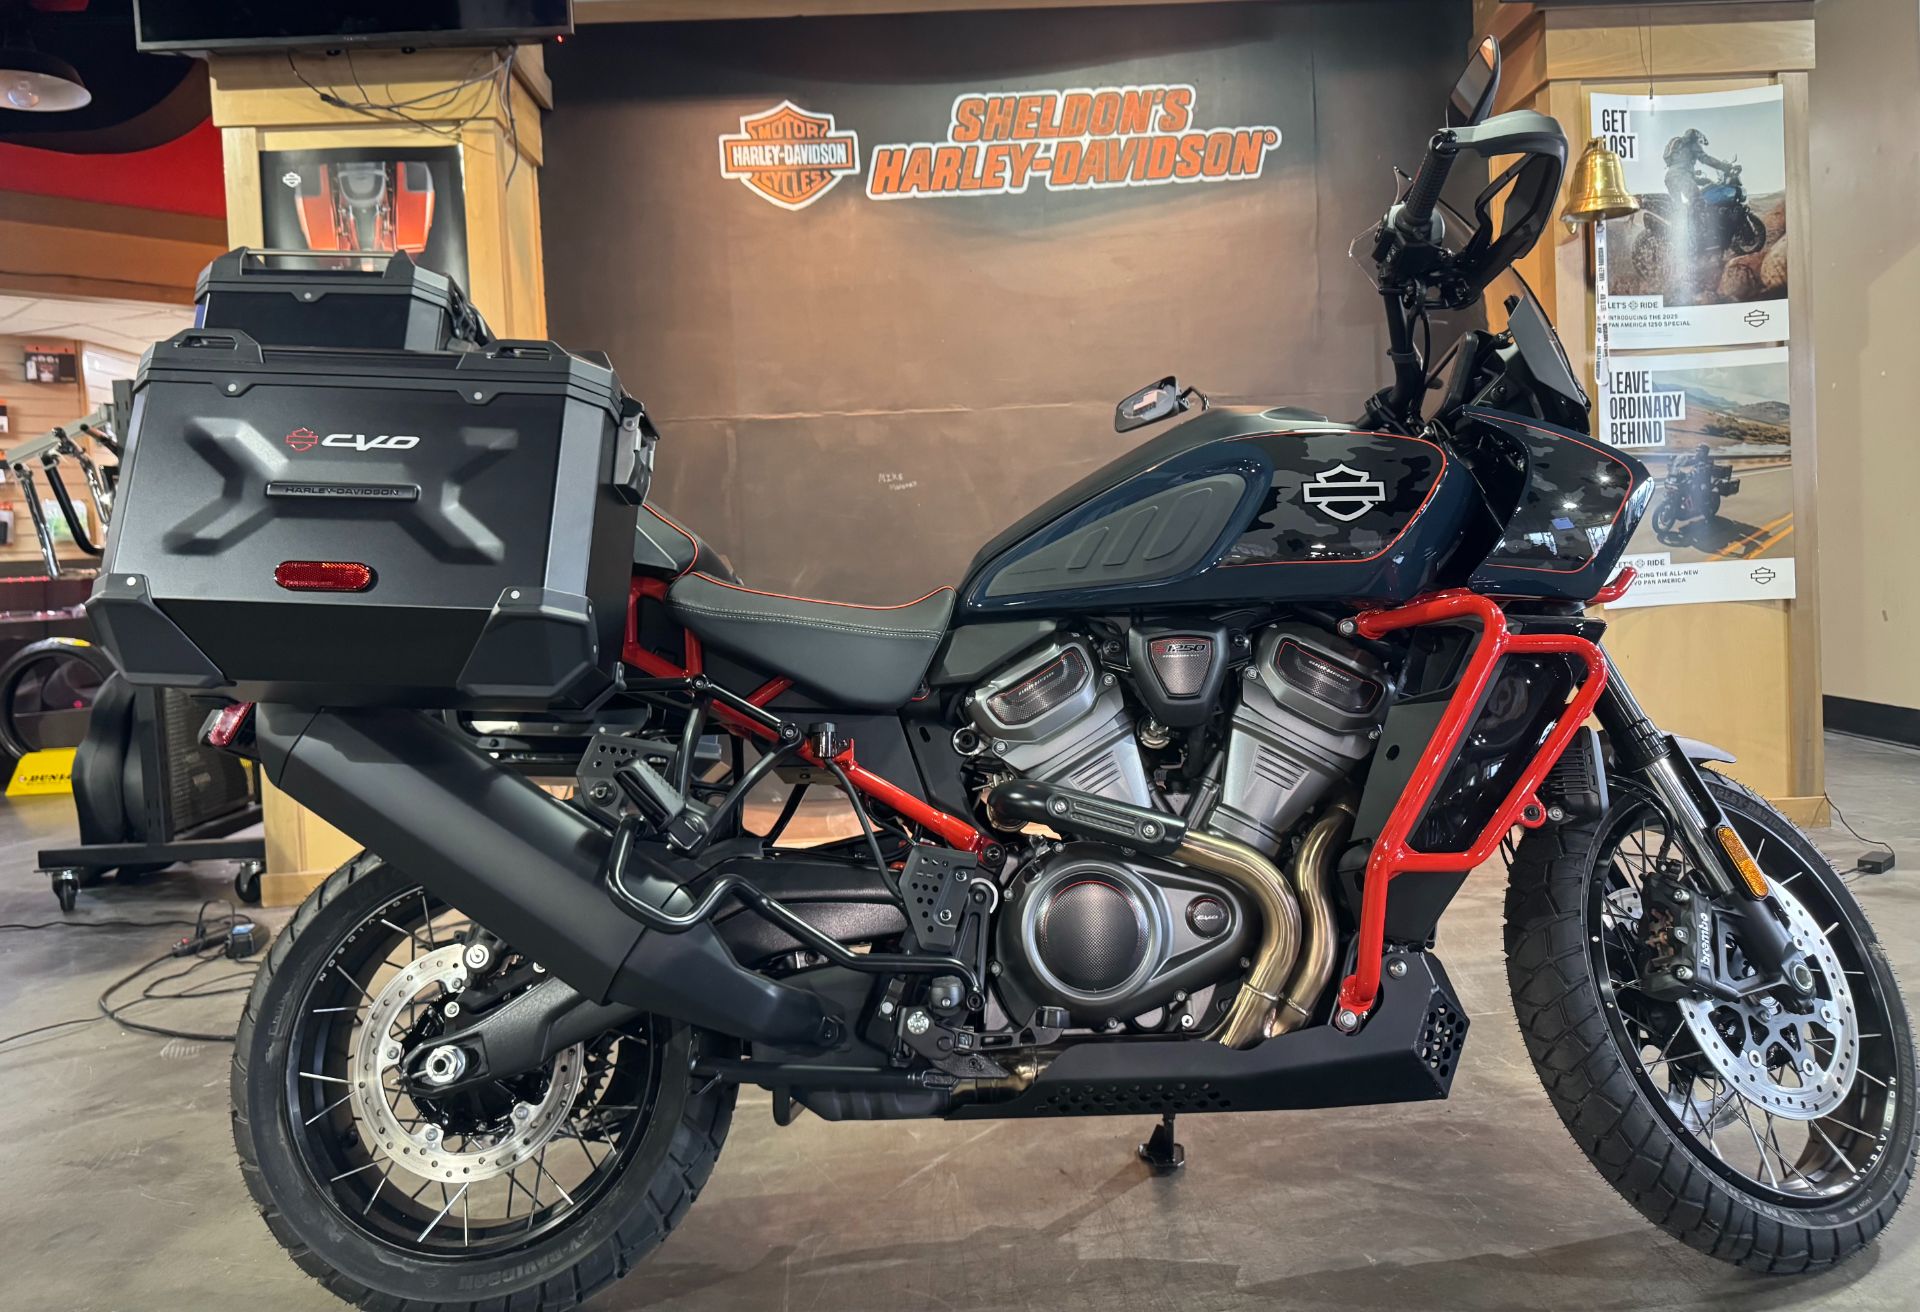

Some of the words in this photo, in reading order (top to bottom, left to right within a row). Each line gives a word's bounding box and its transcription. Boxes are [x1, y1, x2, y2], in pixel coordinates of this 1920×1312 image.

[952, 89, 1191, 142] SHELDON'S
[1602, 109, 1627, 133] GET
[758, 118, 819, 139] MOTOR
[732, 143, 847, 167] HARLEY-DAVIDSON
[760, 170, 822, 197] CYCLES
[1607, 301, 1627, 309] LET'S
[1640, 301, 1659, 309] RIDE
[1609, 370, 1650, 395] LEAVE
[1609, 394, 1682, 420] ORDINARY
[321, 433, 421, 451] CVO
[1611, 421, 1663, 445] BEHIND
[285, 486, 400, 496] HARLEY-DAVIDSON
[1647, 558, 1665, 566] RIDE
[1698, 912, 1710, 968] brembo
